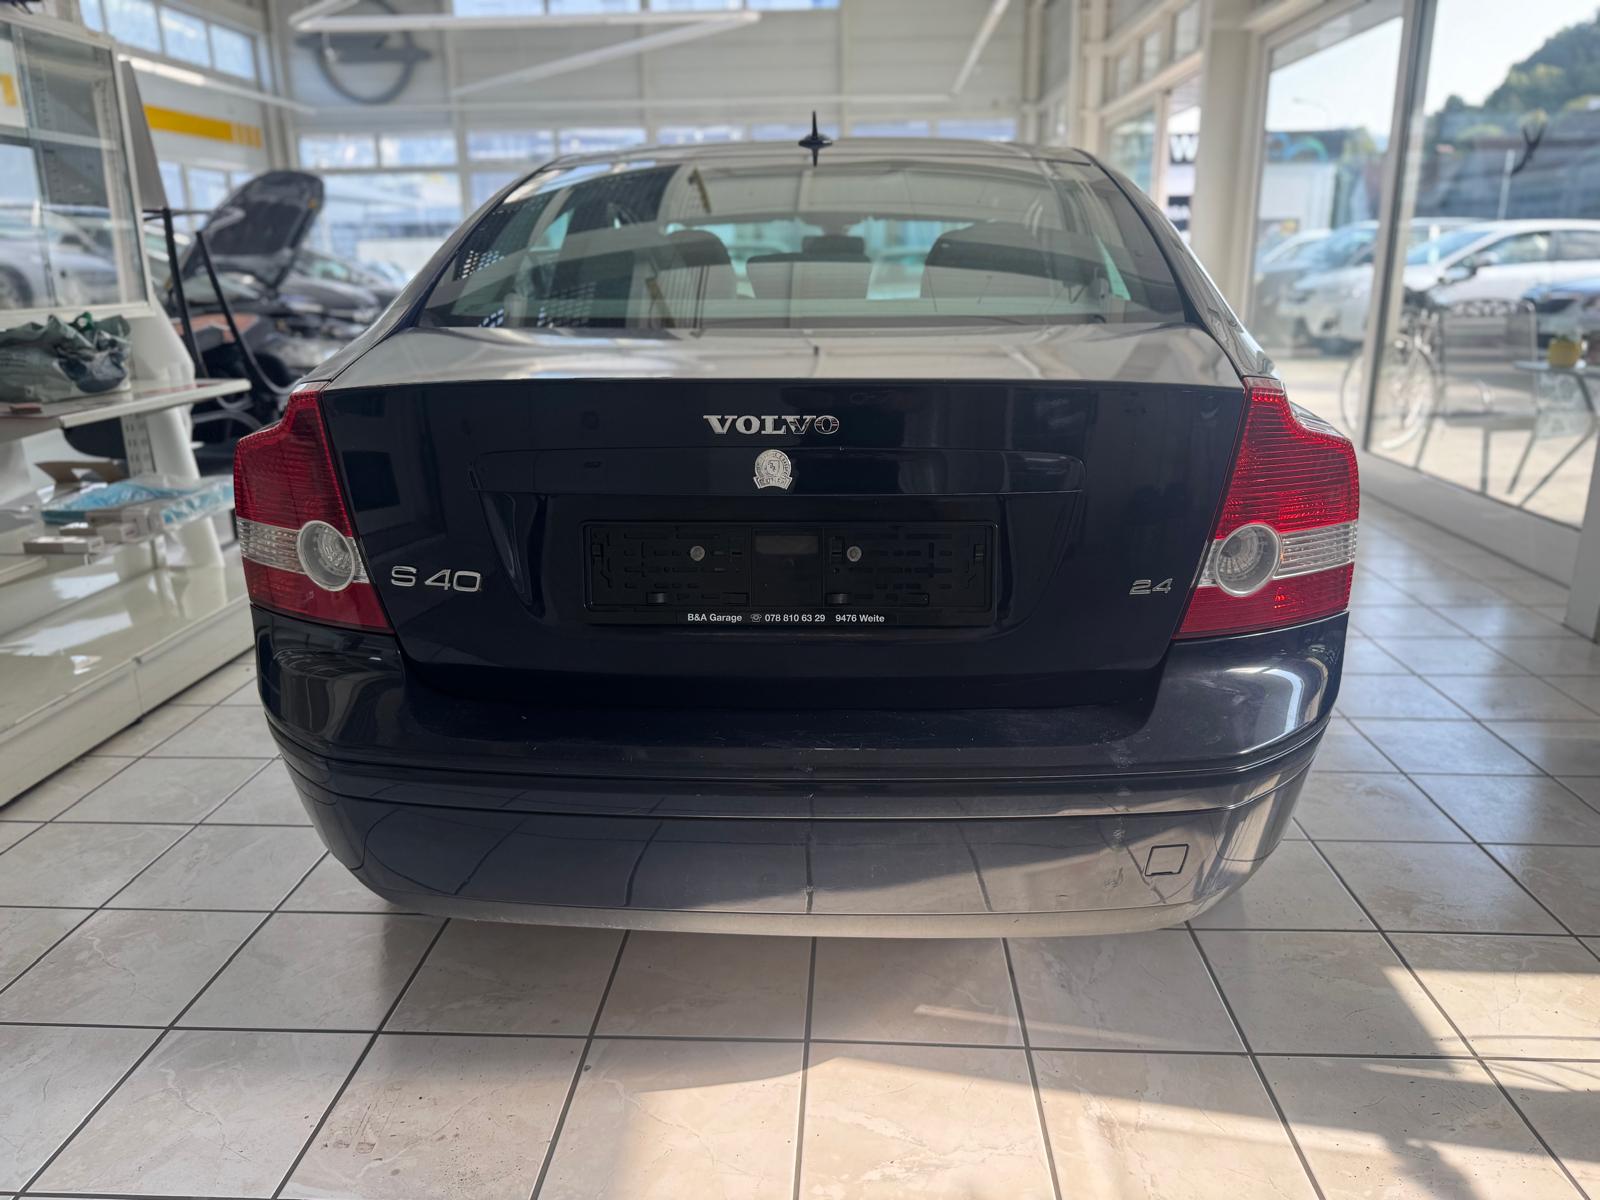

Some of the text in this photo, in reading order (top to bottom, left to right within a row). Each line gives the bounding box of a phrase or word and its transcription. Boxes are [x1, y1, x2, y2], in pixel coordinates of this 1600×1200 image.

[703, 415, 840, 435] VOLVO
[687, 613, 885, 624] B&A Garage 078 810 63 29 9476 Weite
